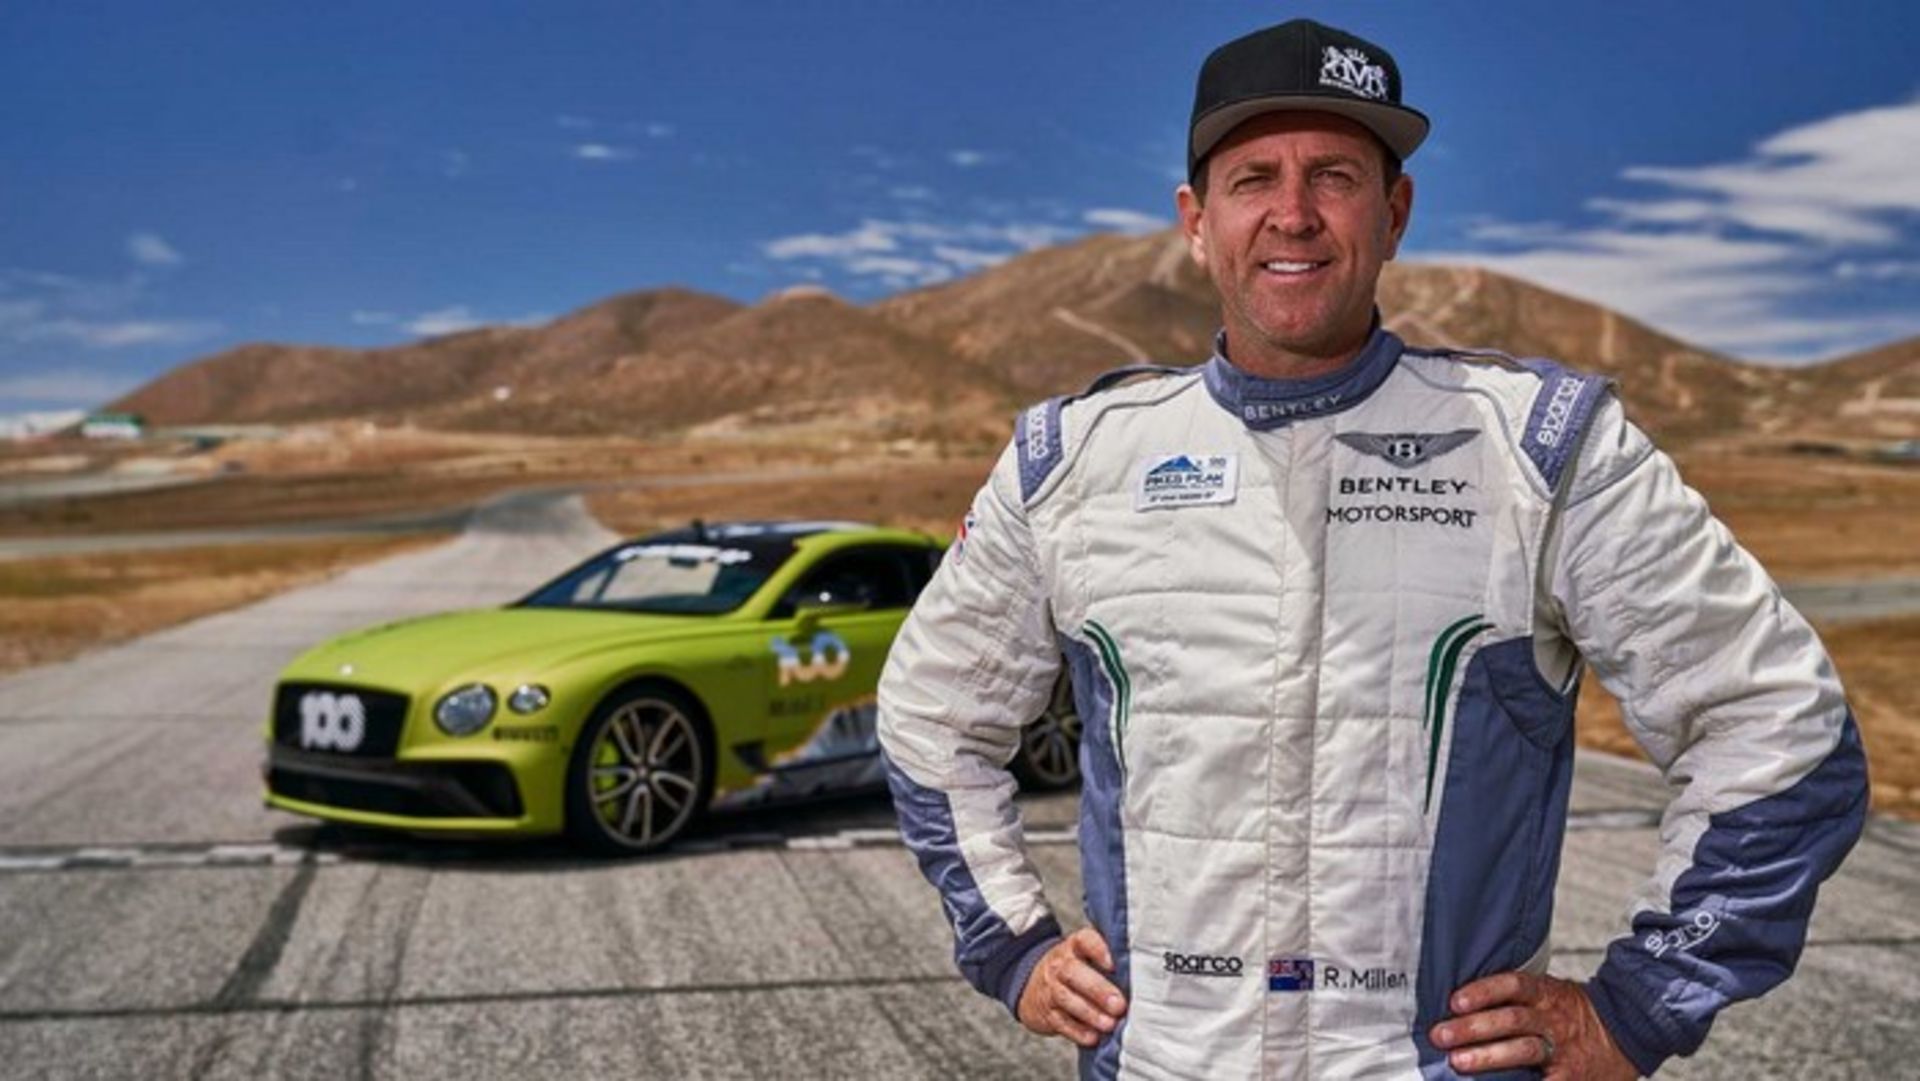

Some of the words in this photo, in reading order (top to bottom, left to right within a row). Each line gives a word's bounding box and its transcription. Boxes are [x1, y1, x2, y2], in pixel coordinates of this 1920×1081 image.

[1244, 394, 1341, 420] BENTLEY
[1536, 378, 1583, 447] sparco
[1340, 477, 1467, 494] BENTLEY
[1326, 505, 1476, 528] MOTORSPORT
[769, 630, 850, 686] 100
[301, 691, 364, 751] 100
[1163, 952, 1243, 976] sparco
